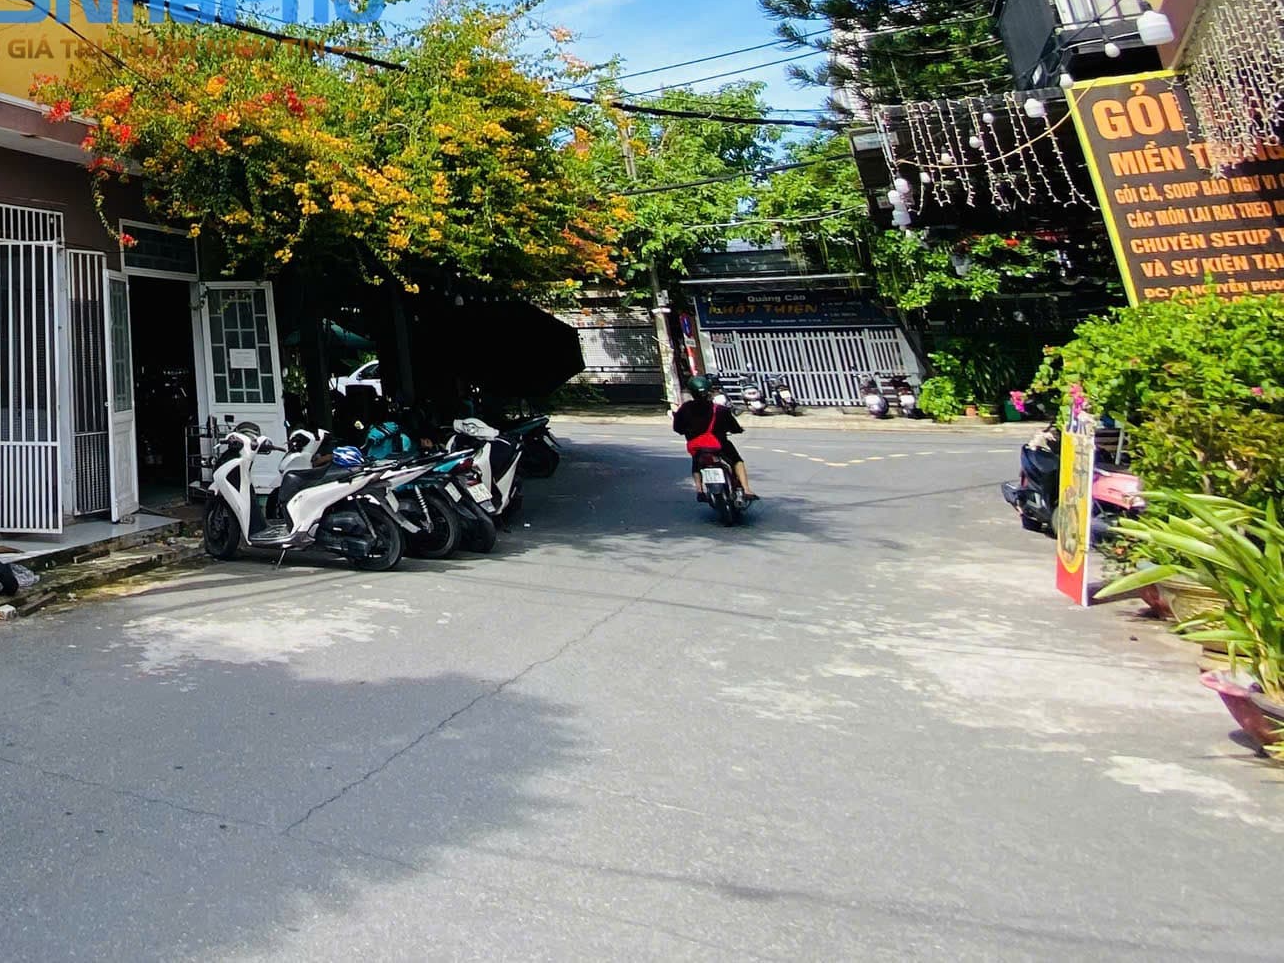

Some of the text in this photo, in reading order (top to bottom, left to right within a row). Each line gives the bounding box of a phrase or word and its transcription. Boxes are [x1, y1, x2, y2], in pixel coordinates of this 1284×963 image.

[1109, 140, 1186, 176] MIỀN
[1163, 182, 1199, 200] SOUP
[1126, 209, 1155, 228] CÁC
[1189, 206, 1212, 223] LAI
[1212, 204, 1237, 221] RAI
[1236, 201, 1273, 219] THEO
[1130, 232, 1207, 254] CHUYÊN
[1210, 228, 1272, 248] SETUP
[1140, 258, 1169, 278] VÀ
[1171, 257, 1199, 278] SỰ
[1201, 253, 1250, 275] KIỆN
